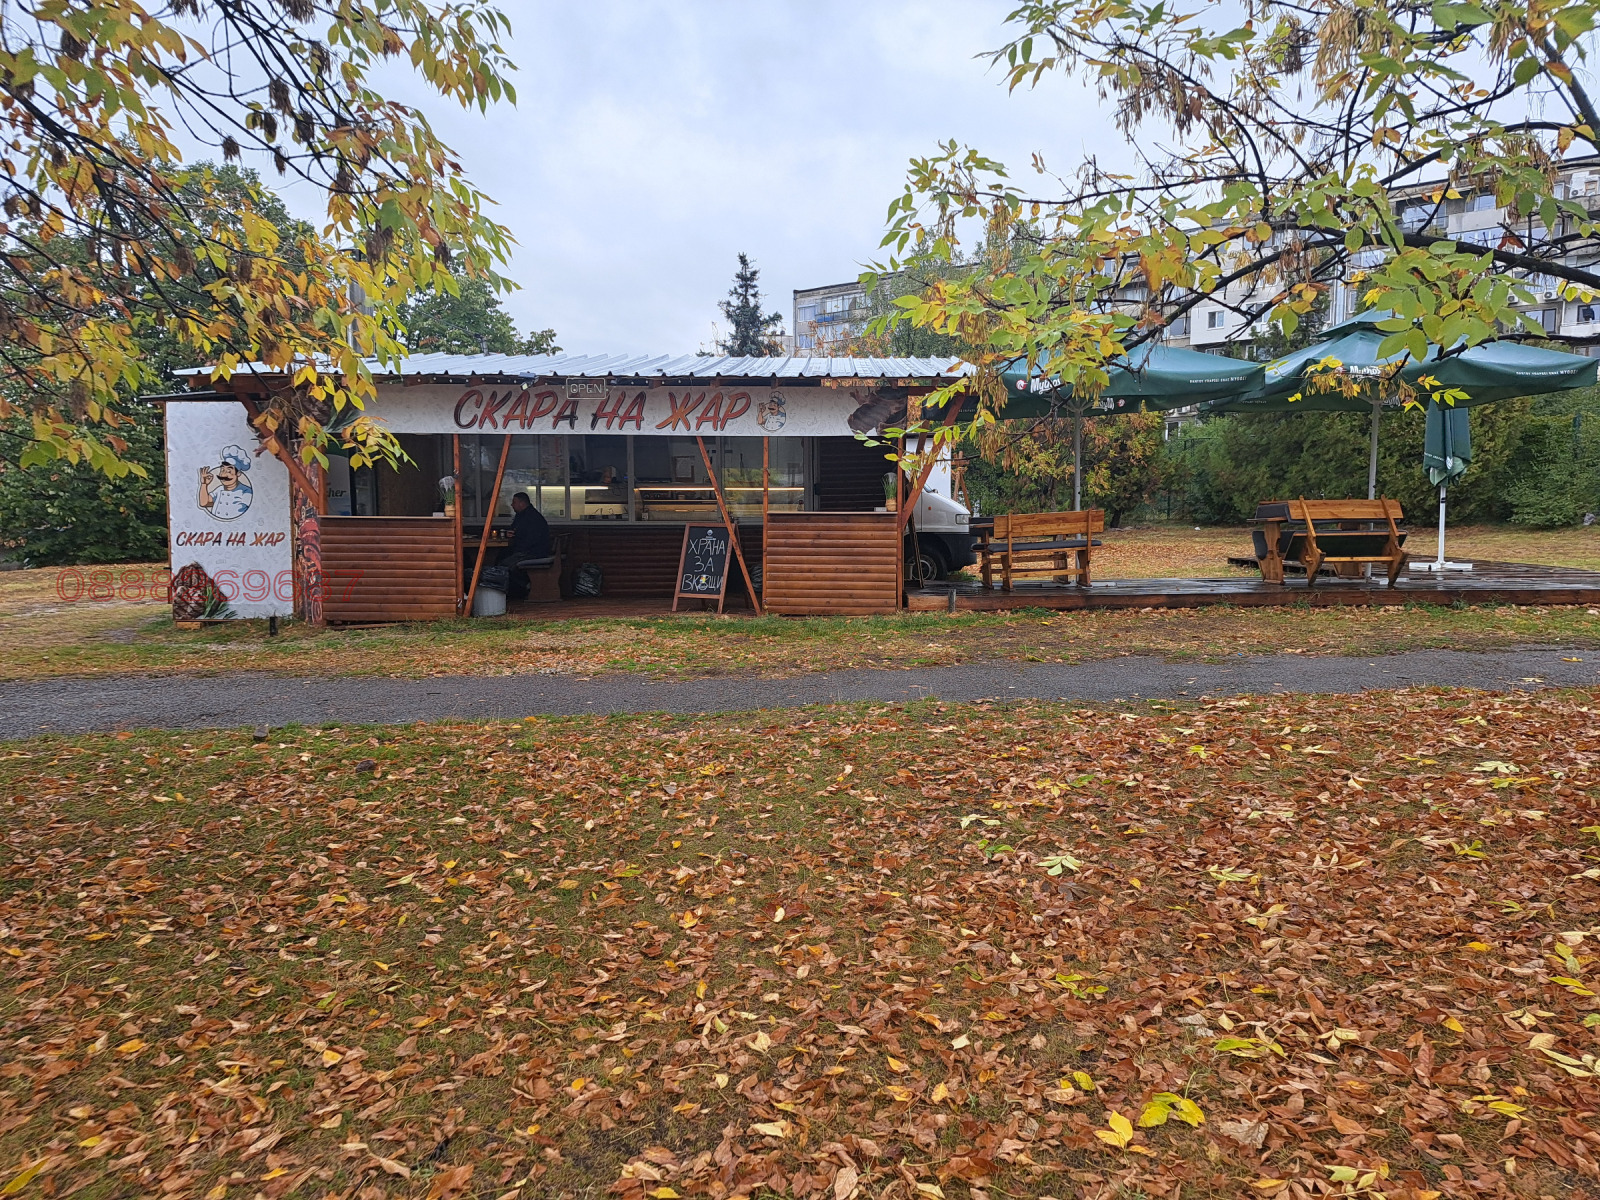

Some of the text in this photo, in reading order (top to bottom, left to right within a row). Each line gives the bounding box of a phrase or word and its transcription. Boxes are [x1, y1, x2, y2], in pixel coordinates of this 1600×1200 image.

[570, 383, 602, 394] OPEN
[453, 390, 751, 430] СКАРА НА ЖАР
[176, 531, 286, 546] СКАРА НА ЖАР
[688, 538, 725, 555] ХРАНА
[694, 556, 714, 572] ЗА
